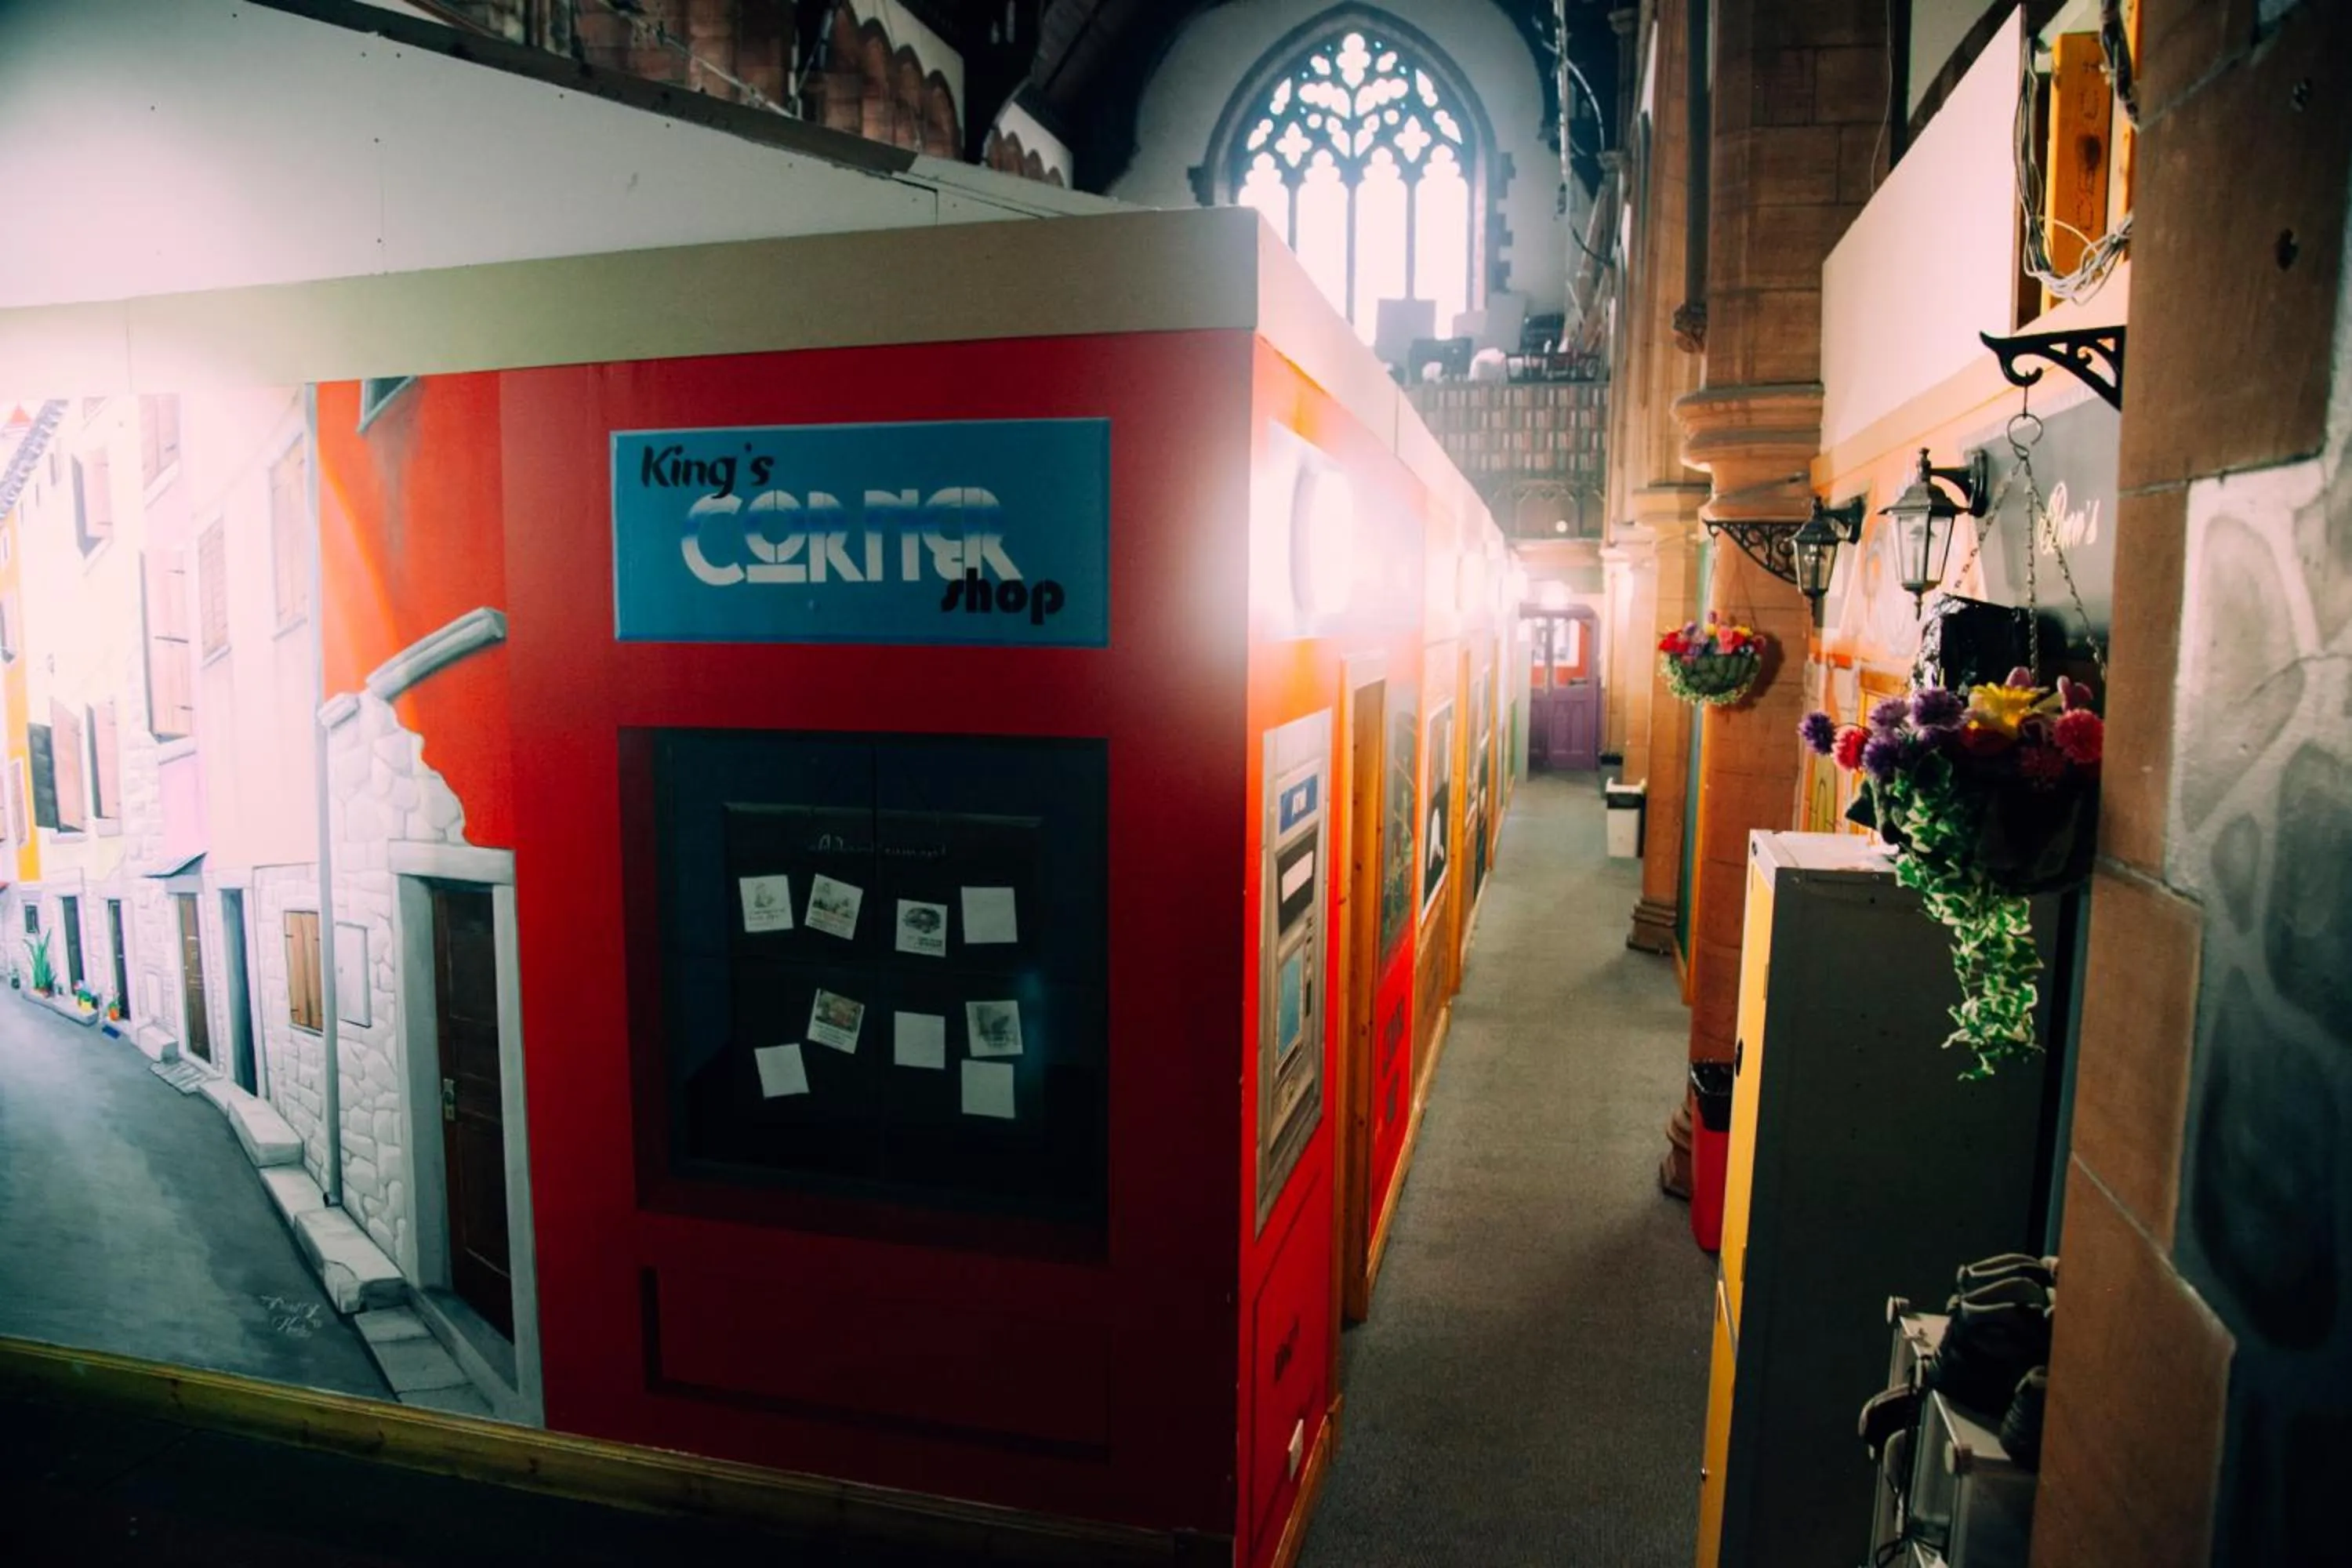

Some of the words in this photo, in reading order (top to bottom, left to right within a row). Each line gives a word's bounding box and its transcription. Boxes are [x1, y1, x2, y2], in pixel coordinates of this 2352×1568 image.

[641, 443, 775, 498] King's
[681, 487, 1024, 586] CORNER
[941, 567, 1065, 625] shop
